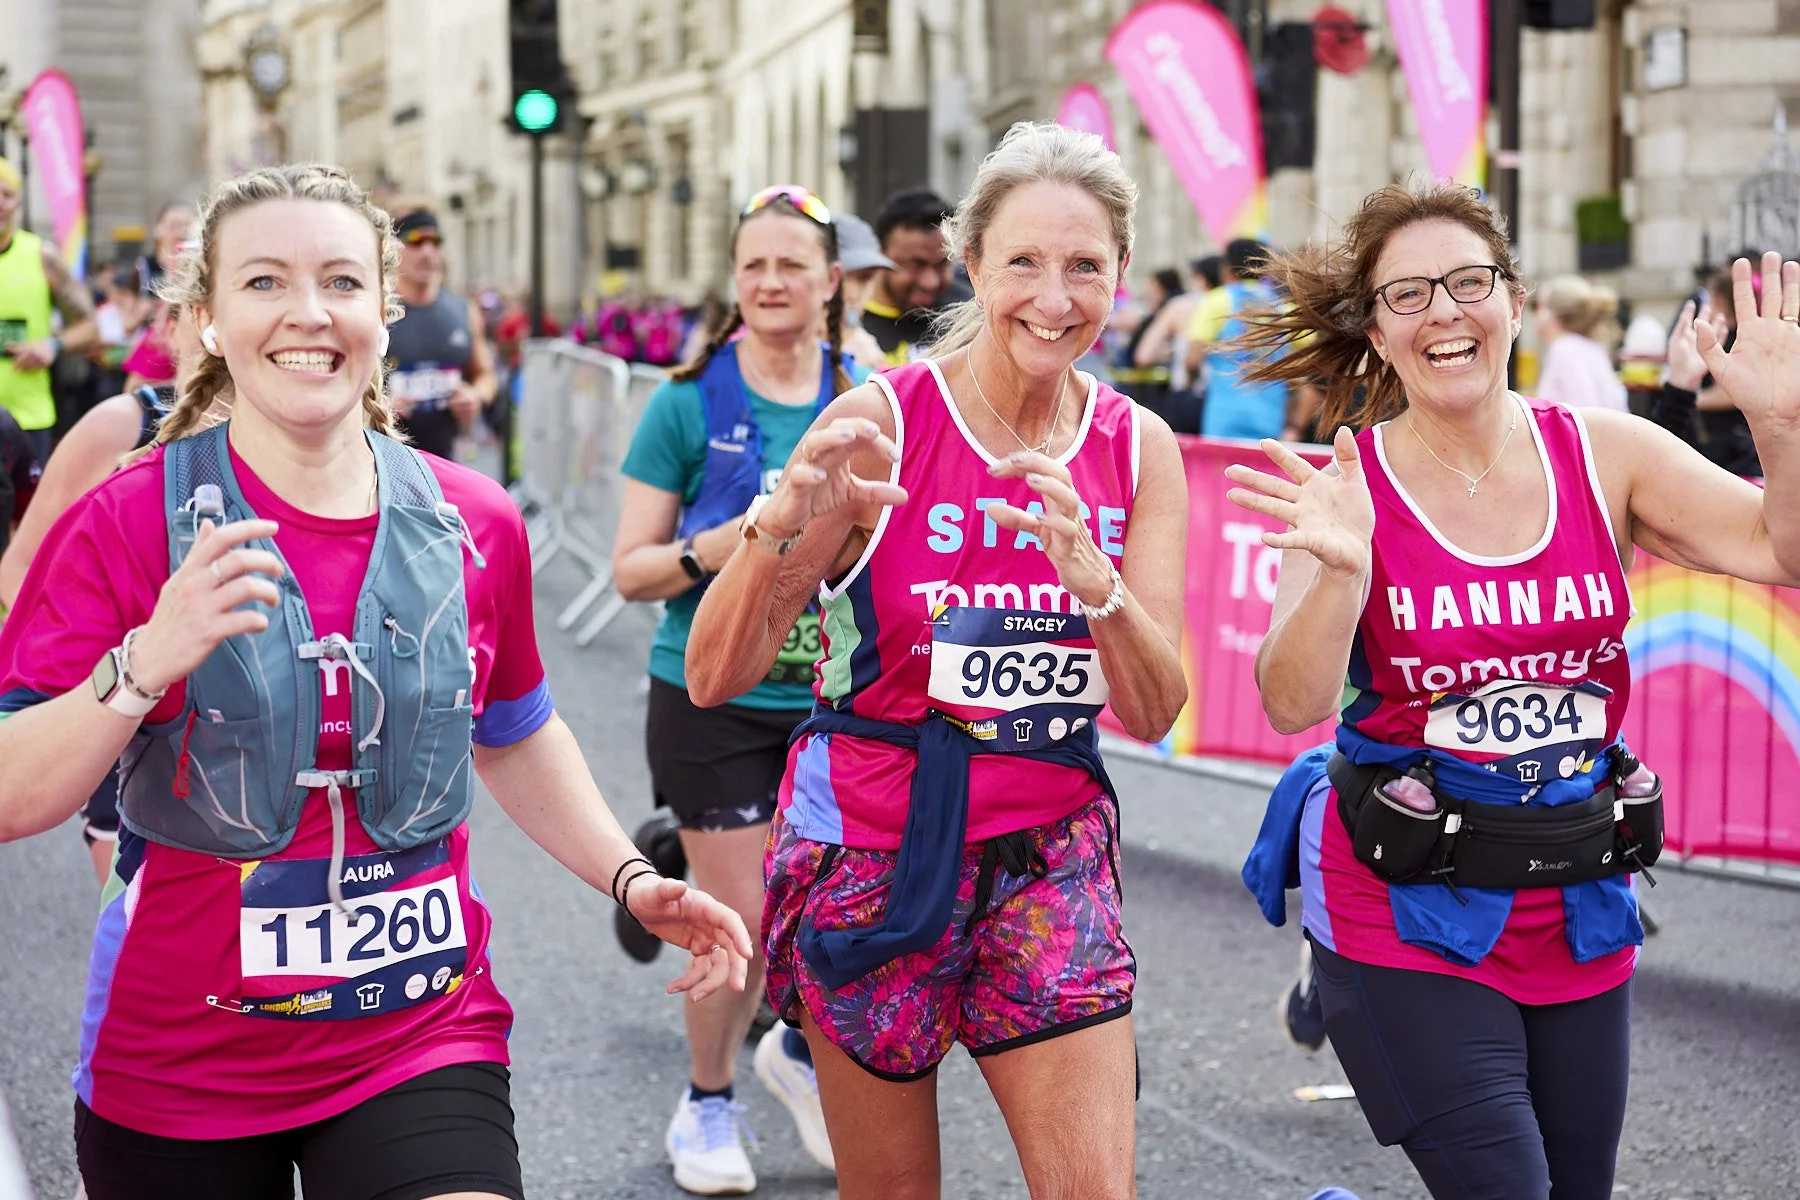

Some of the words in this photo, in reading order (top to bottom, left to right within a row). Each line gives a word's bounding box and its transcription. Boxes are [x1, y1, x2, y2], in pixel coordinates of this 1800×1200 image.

[926, 497, 1126, 557] STAE
[1003, 615, 1067, 632] STACEY
[1387, 572, 1614, 631] HANNAH
[962, 650, 1092, 699] 9635
[1390, 637, 1624, 693] Tommy's
[1456, 692, 1583, 744] 9634
[261, 888, 452, 967] 11260
[260, 1001, 292, 1013] LONDON
